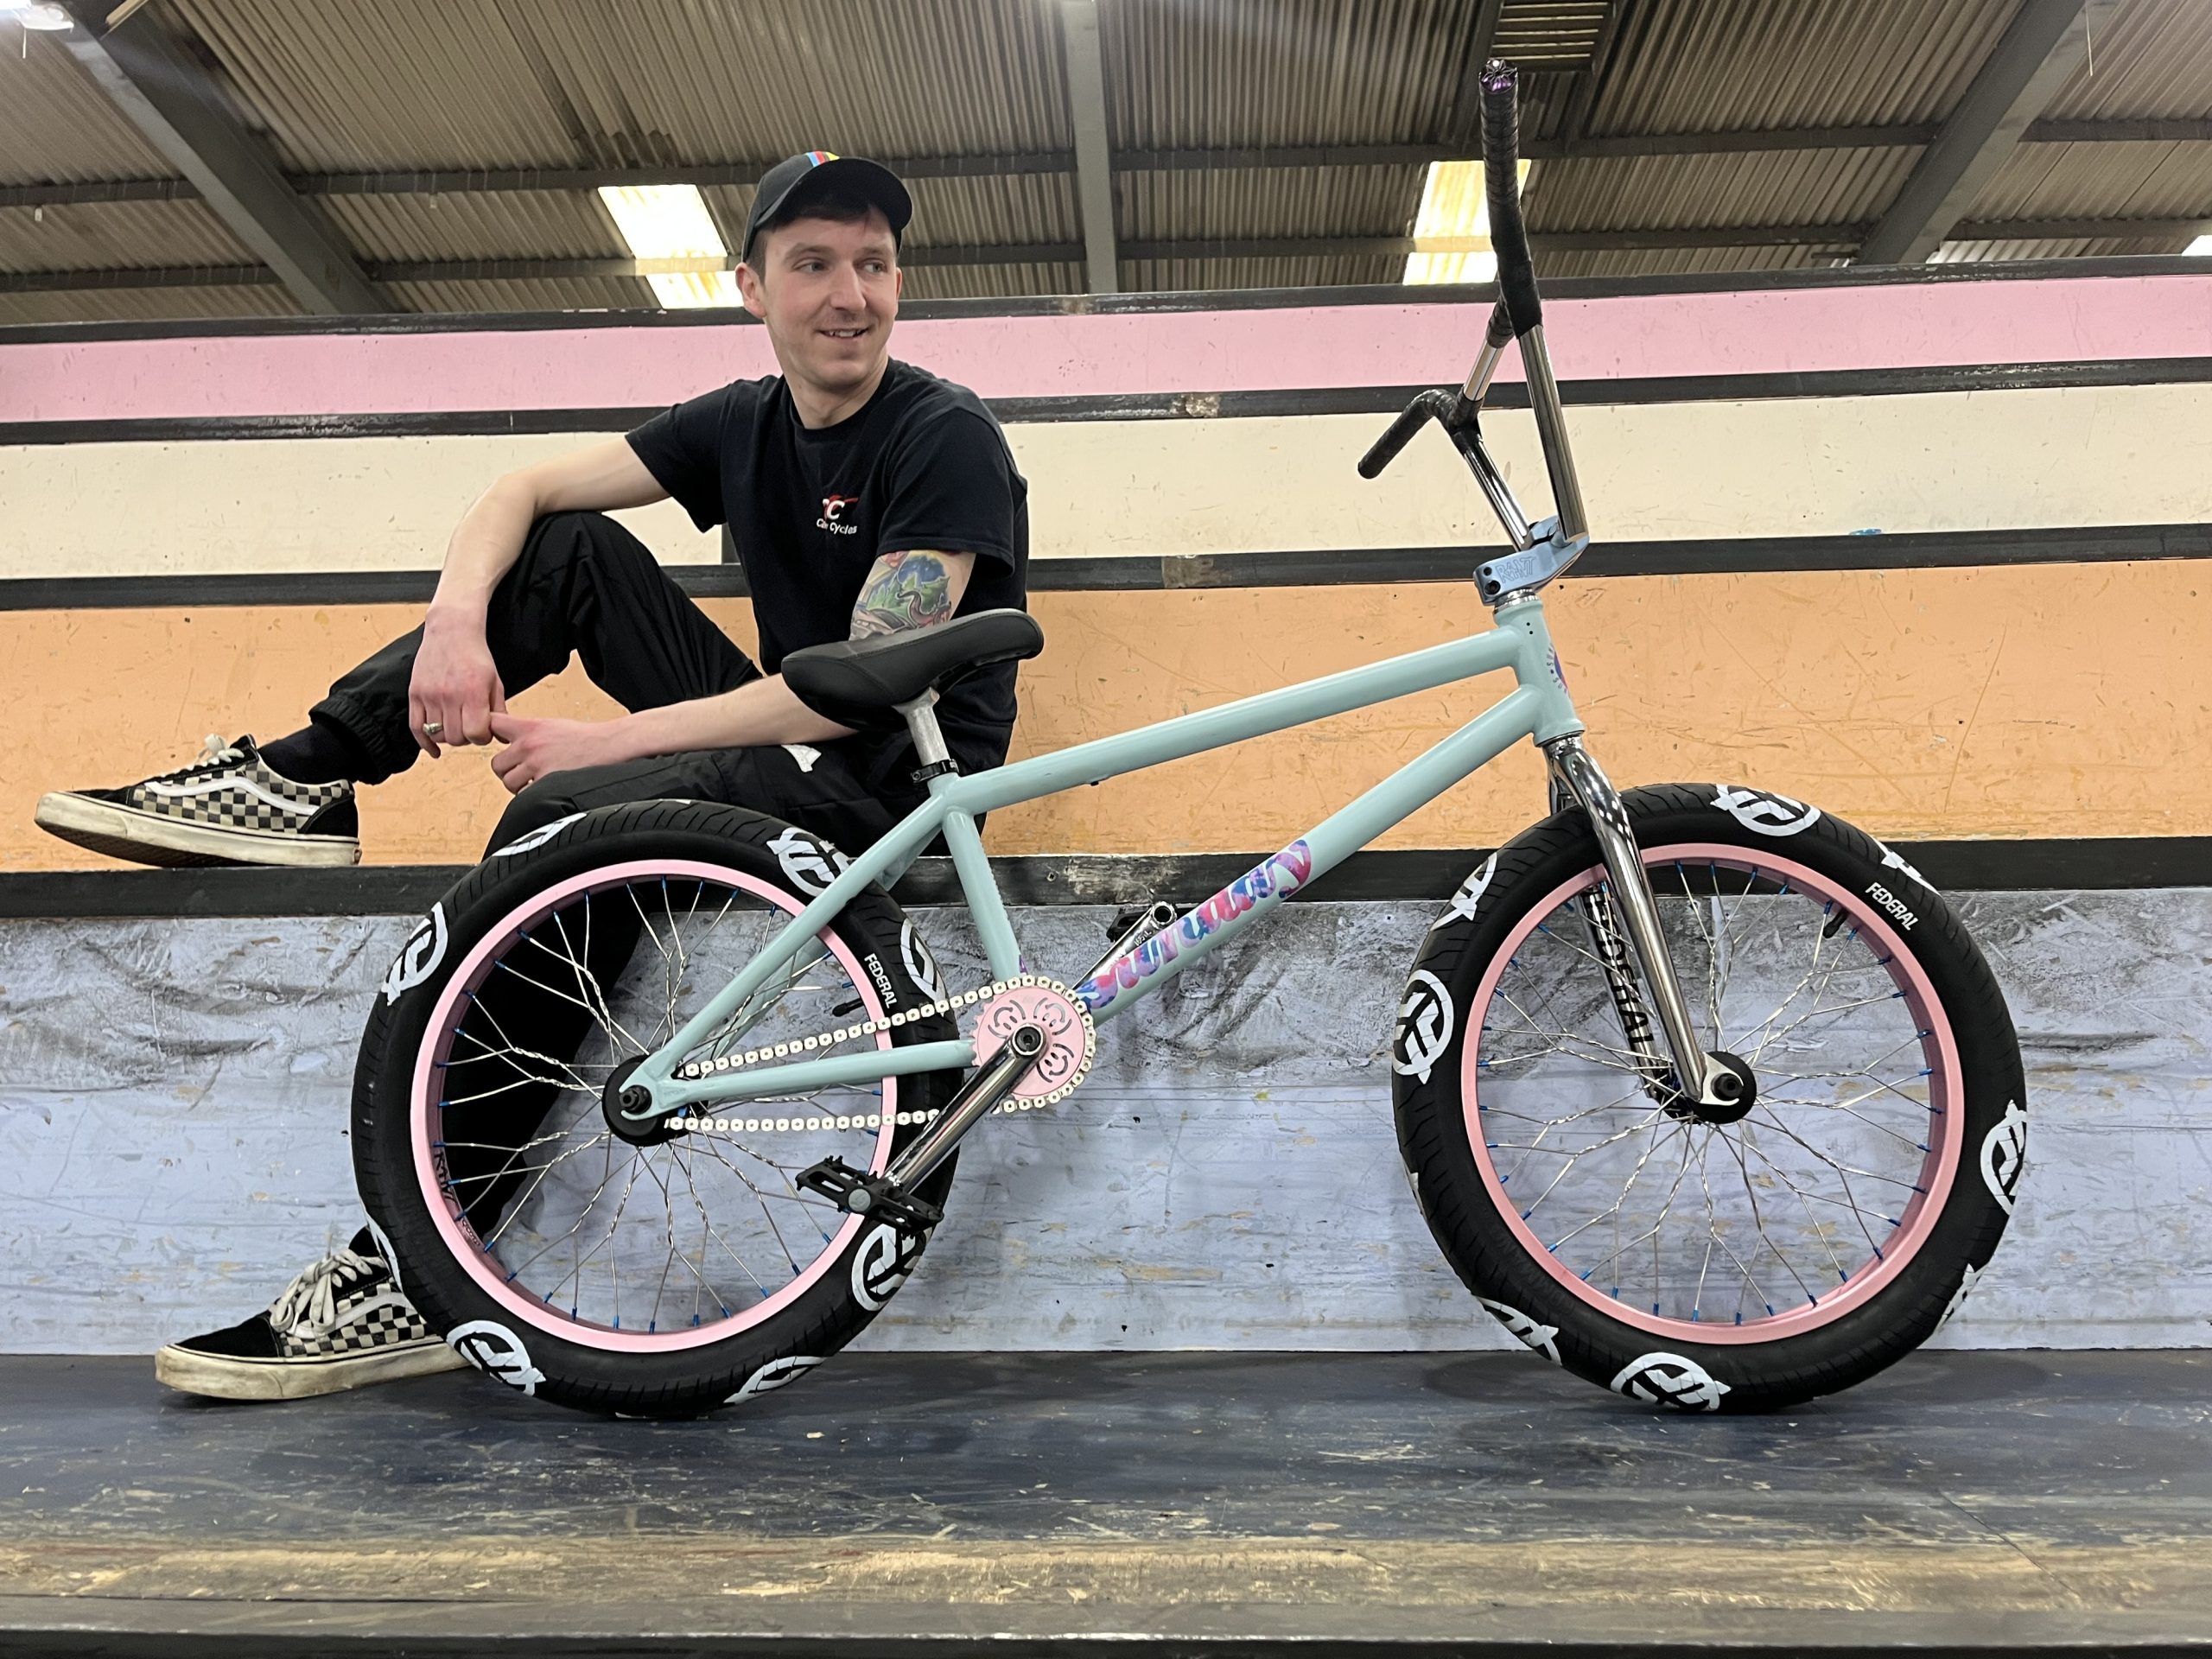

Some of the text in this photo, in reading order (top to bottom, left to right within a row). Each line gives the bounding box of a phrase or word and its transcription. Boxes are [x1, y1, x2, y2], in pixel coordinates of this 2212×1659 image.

[1495, 556, 1537, 584] RANT
[1865, 881, 1919, 931] FEDERAL
[864, 952, 898, 1008] FEDERAL
